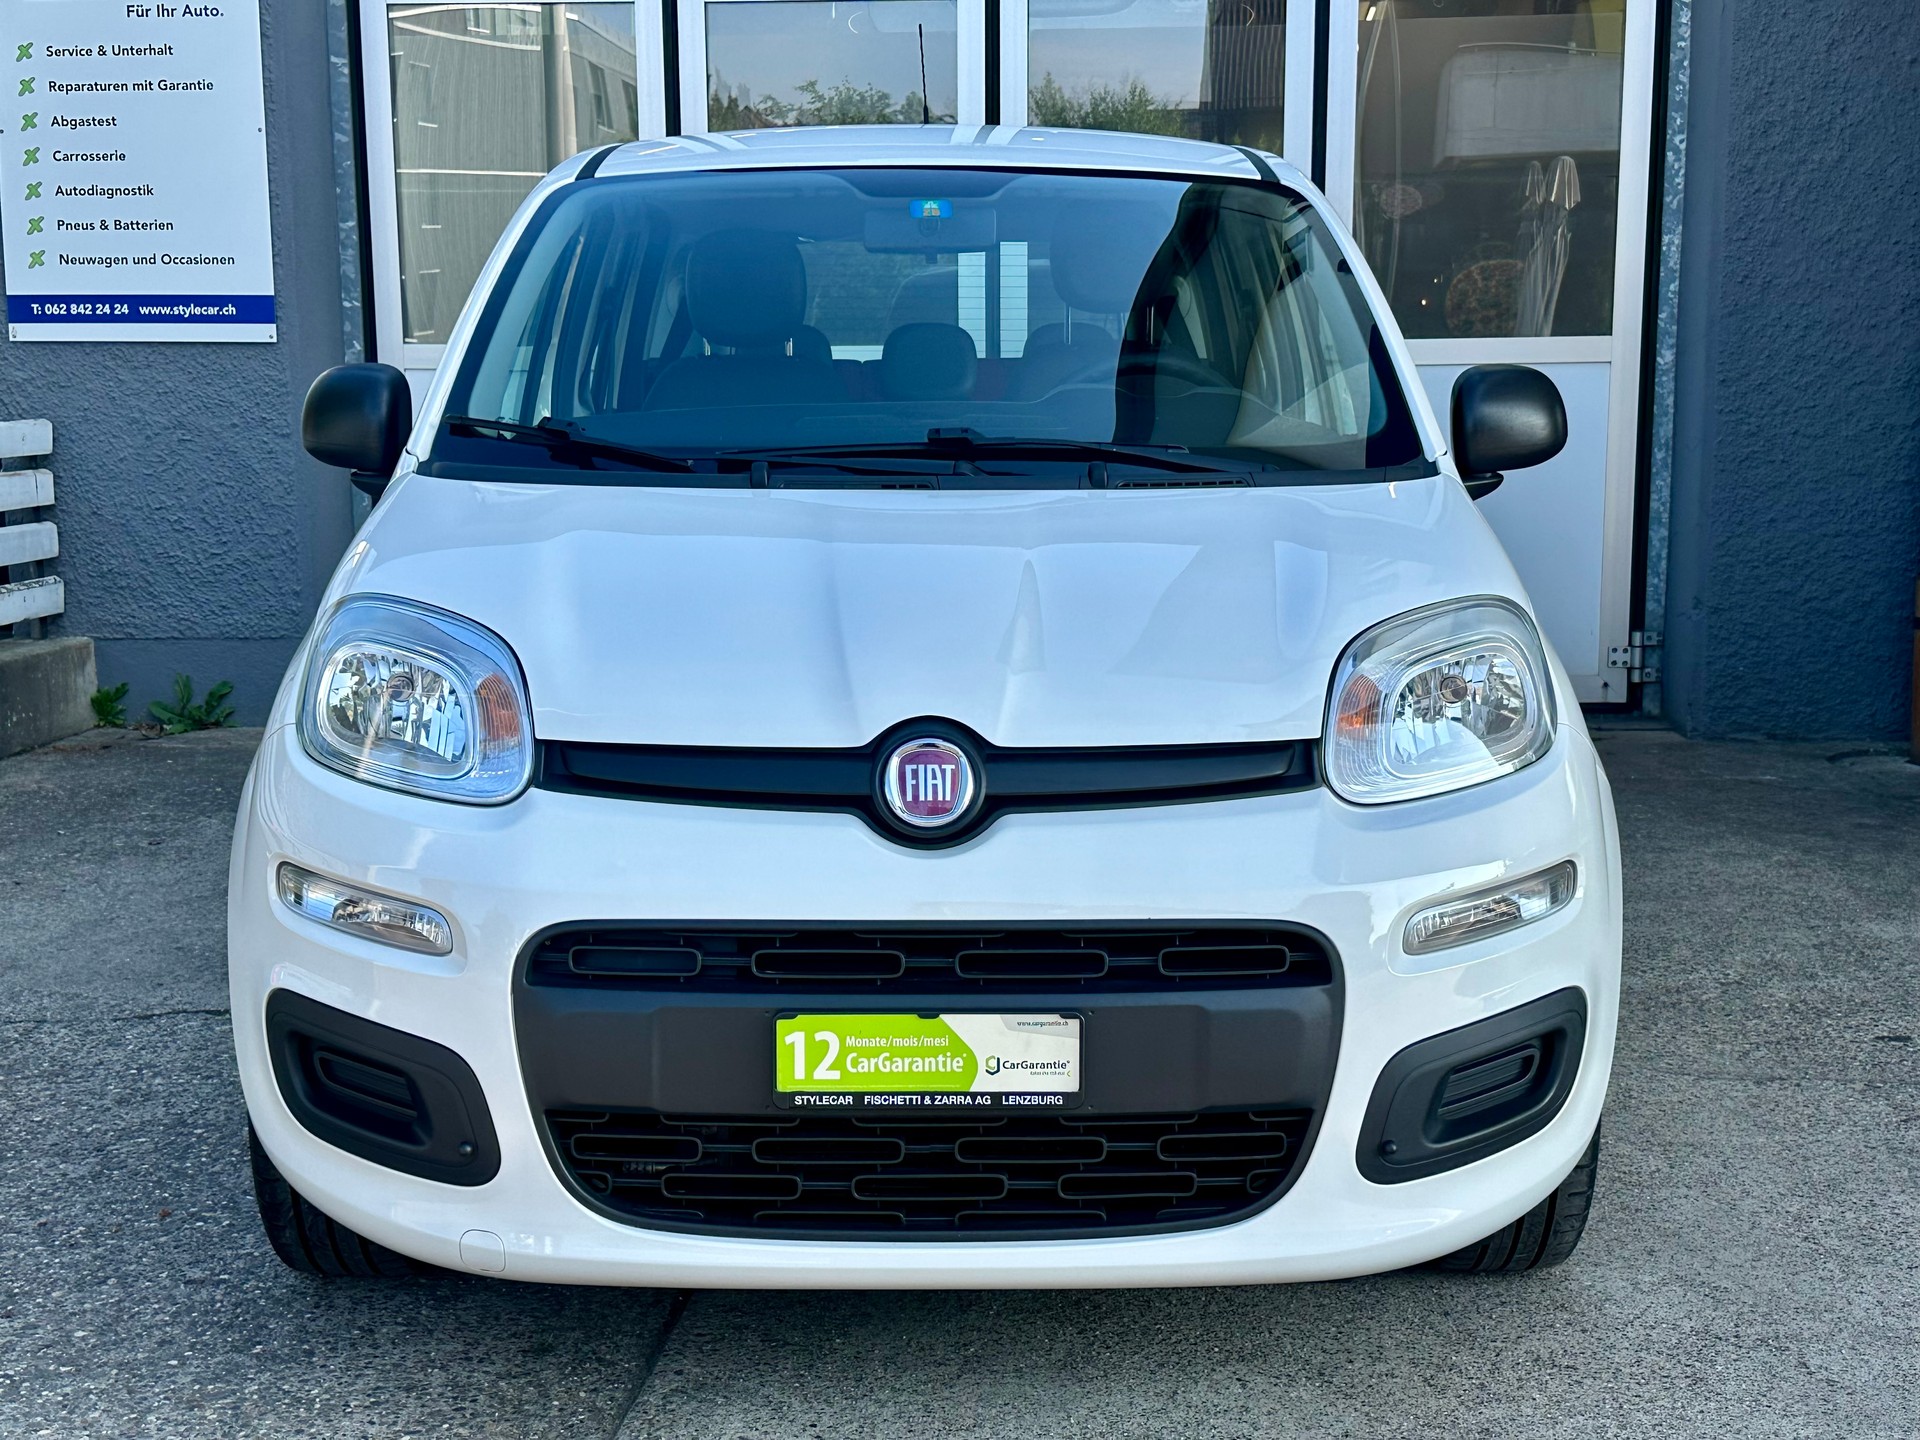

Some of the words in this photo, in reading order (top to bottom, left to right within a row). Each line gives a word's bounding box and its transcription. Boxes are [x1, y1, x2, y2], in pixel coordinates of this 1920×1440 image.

[126, 4, 151, 18] Für
[156, 4, 177, 18] Ihr
[181, 4, 225, 18] Auto.
[46, 45, 93, 57] Service
[97, 45, 108, 57] &
[111, 43, 174, 57] Unterhalt
[48, 80, 129, 95] Reparaturen
[132, 79, 154, 92] mit
[157, 79, 214, 92] Garantie
[51, 115, 117, 130] Abgastest
[52, 150, 126, 162] Carrosserie
[55, 184, 154, 199] Autodiagnostik
[56, 219, 96, 232] Pneus
[99, 219, 110, 231] &
[113, 219, 174, 231] Batterien
[59, 254, 128, 268] Neuwagen
[132, 253, 157, 265] und
[160, 253, 235, 265] Occasionen
[31, 303, 42, 315] T:
[44, 303, 67, 315] 062
[70, 303, 93, 315] 842
[95, 303, 111, 315] 24
[113, 303, 129, 315] 24
[139, 303, 237, 318] www.stylecar.ch
[905, 764, 955, 802] FIAT
[846, 1035, 949, 1048] Monate/mois/mesi
[784, 1030, 841, 1080] 12
[794, 1096, 853, 1105] STYLECAR
[864, 1096, 921, 1105] FISCHETTI
[924, 1096, 932, 1105] &
[934, 1096, 972, 1105] ZARRA
[974, 1096, 991, 1105] AG
[1002, 1096, 1063, 1105] LENZBURG
